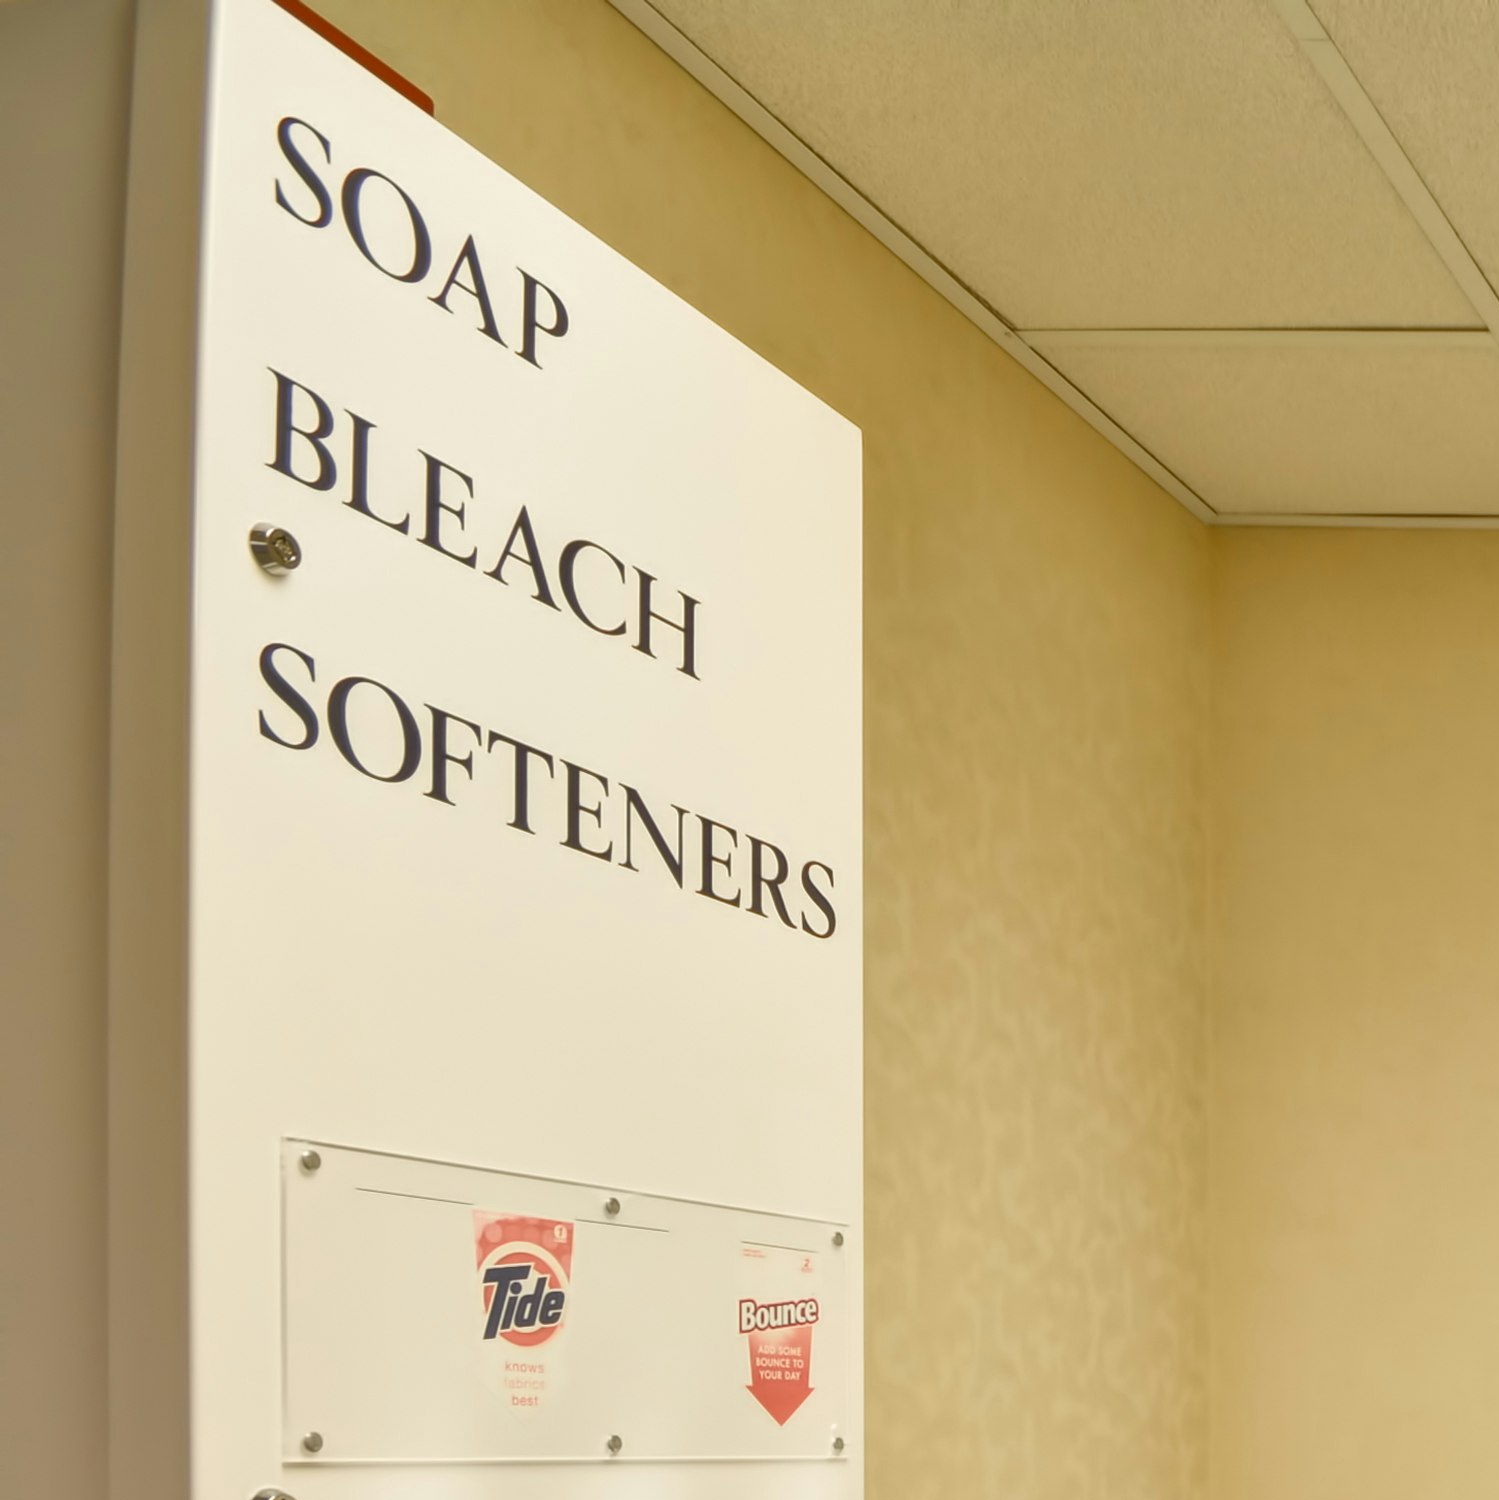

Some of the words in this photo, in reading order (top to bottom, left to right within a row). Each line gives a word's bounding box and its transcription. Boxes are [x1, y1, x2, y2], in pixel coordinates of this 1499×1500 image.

[274, 116, 570, 370] SOAP
[264, 367, 703, 681] BLEACH
[257, 642, 838, 940] SOFTENERS
[482, 1264, 566, 1340] Tide
[739, 1299, 819, 1334] Bounce
[757, 1345, 776, 1355] ADD
[777, 1346, 803, 1357] SOME
[504, 1361, 545, 1373] knows
[756, 1357, 791, 1368] BOUNCE
[793, 1358, 805, 1369] TO
[759, 1369, 784, 1380] YOUR
[784, 1370, 802, 1381] DAY
[504, 1377, 545, 1390] fabrics
[511, 1395, 539, 1406] best
